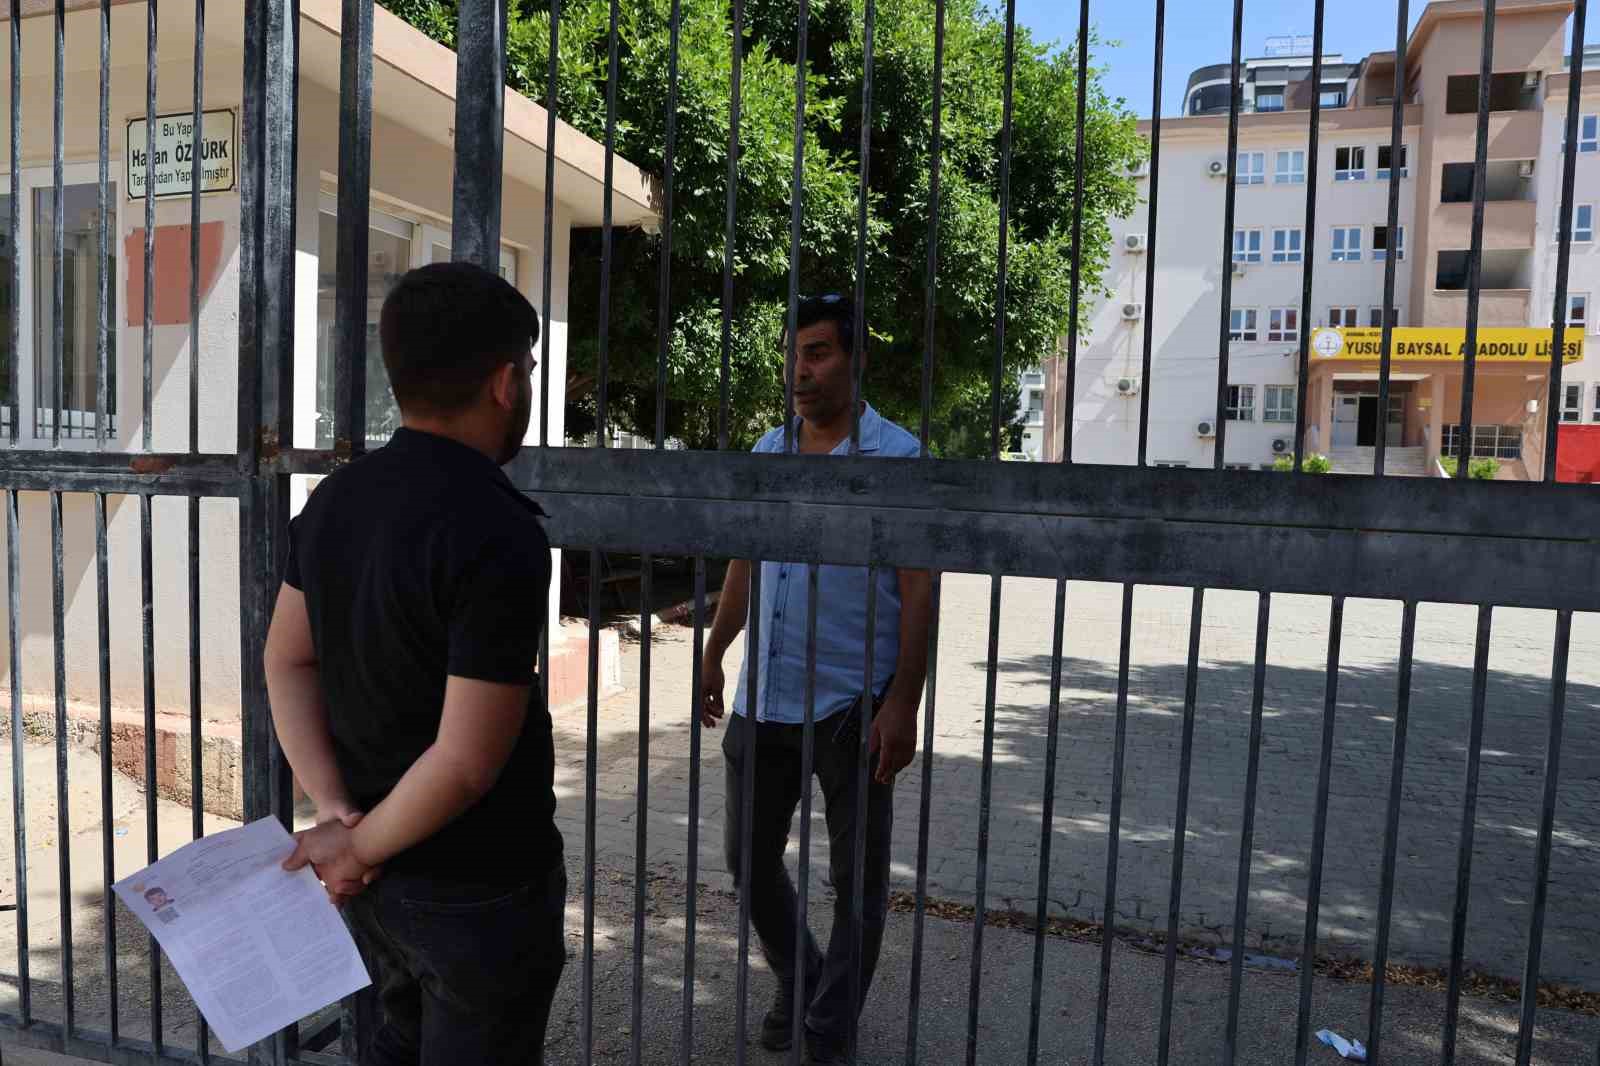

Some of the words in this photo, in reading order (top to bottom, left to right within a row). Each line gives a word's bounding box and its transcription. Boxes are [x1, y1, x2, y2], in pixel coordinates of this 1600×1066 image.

[163, 123, 175, 137] Bu
[176, 121, 196, 137] Yap
[132, 149, 168, 167] Haan
[175, 138, 228, 162] ÖZÜRK
[1345, 341, 1388, 355] YUSU
[1397, 342, 1452, 356] BAYSAL
[1458, 342, 1528, 356] AADOLU
